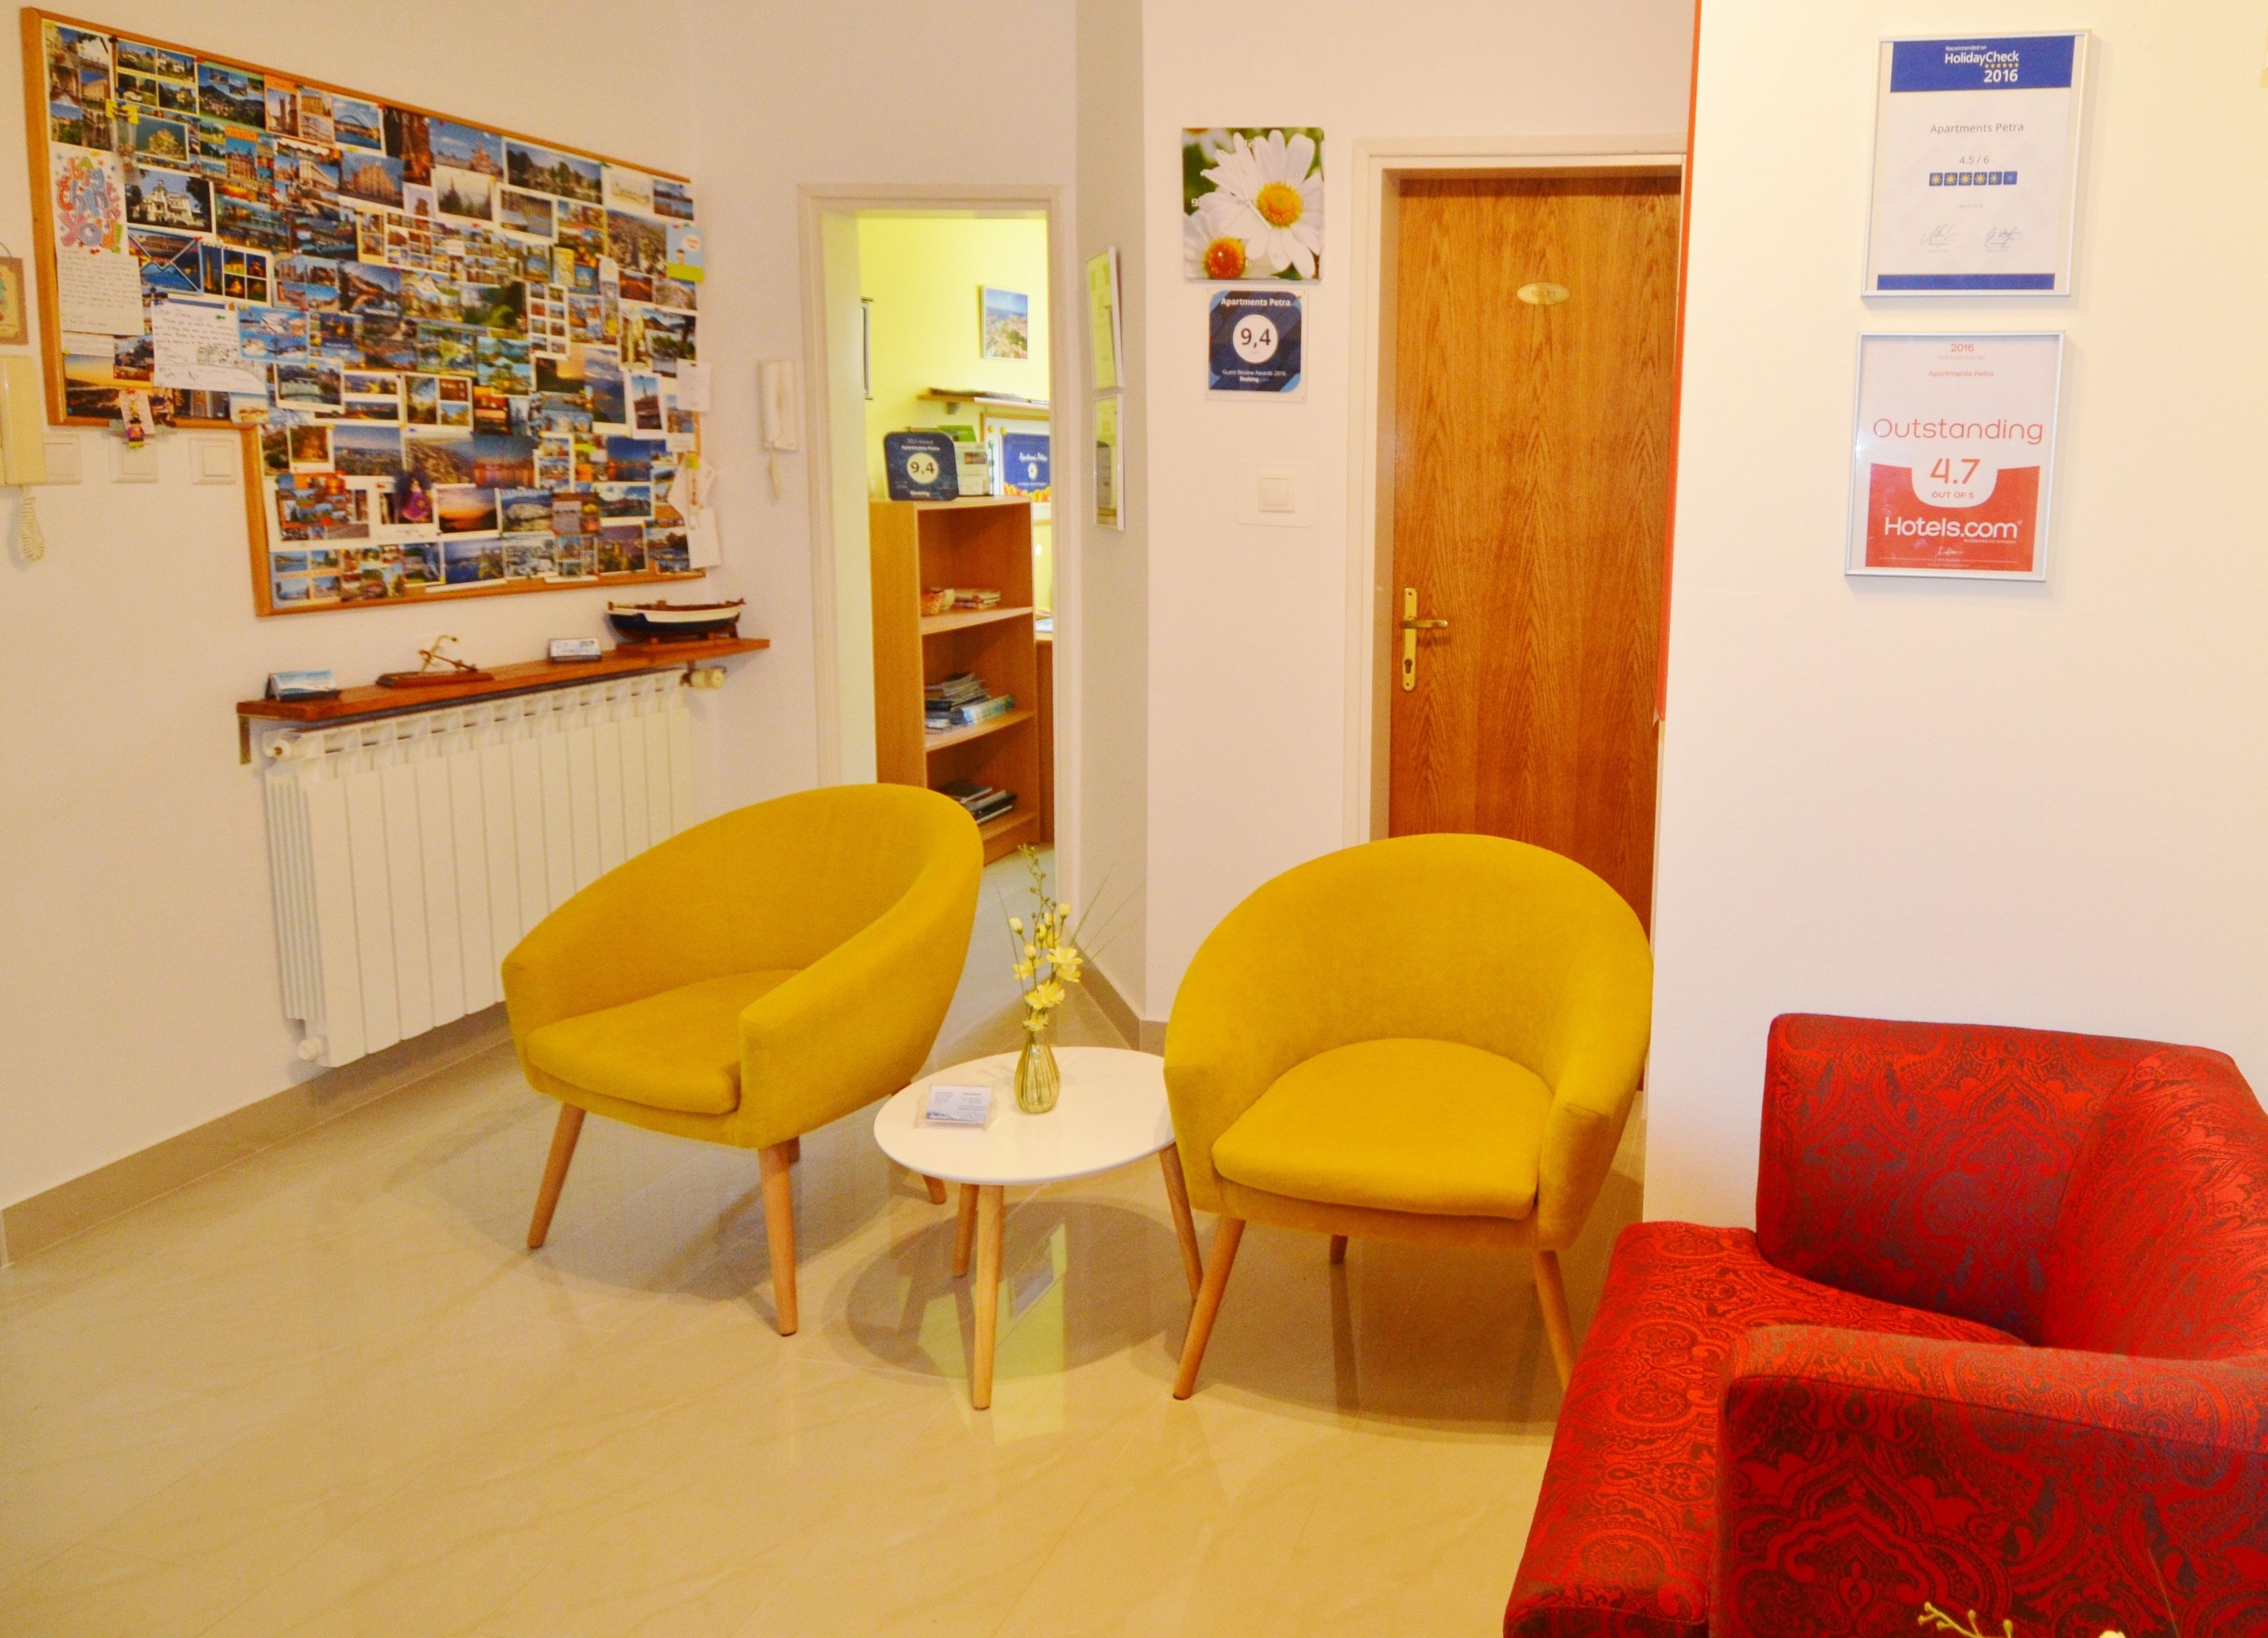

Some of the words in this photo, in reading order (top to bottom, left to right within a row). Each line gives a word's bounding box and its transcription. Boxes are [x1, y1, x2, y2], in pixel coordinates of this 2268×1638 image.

[1945, 50, 2019, 66] HolidayCheck
[1984, 69, 2018, 83] 2016
[1930, 124, 1992, 135] Apartments
[1984, 155, 1990, 164] 6
[1221, 297, 1267, 307] Apartments
[1240, 328, 1271, 348] 9,4
[1951, 343, 1974, 352] 2016
[1873, 418, 2043, 445] Outstanding
[1930, 458, 1980, 484] 4.7
[1884, 516, 2018, 538] Hotels.com
